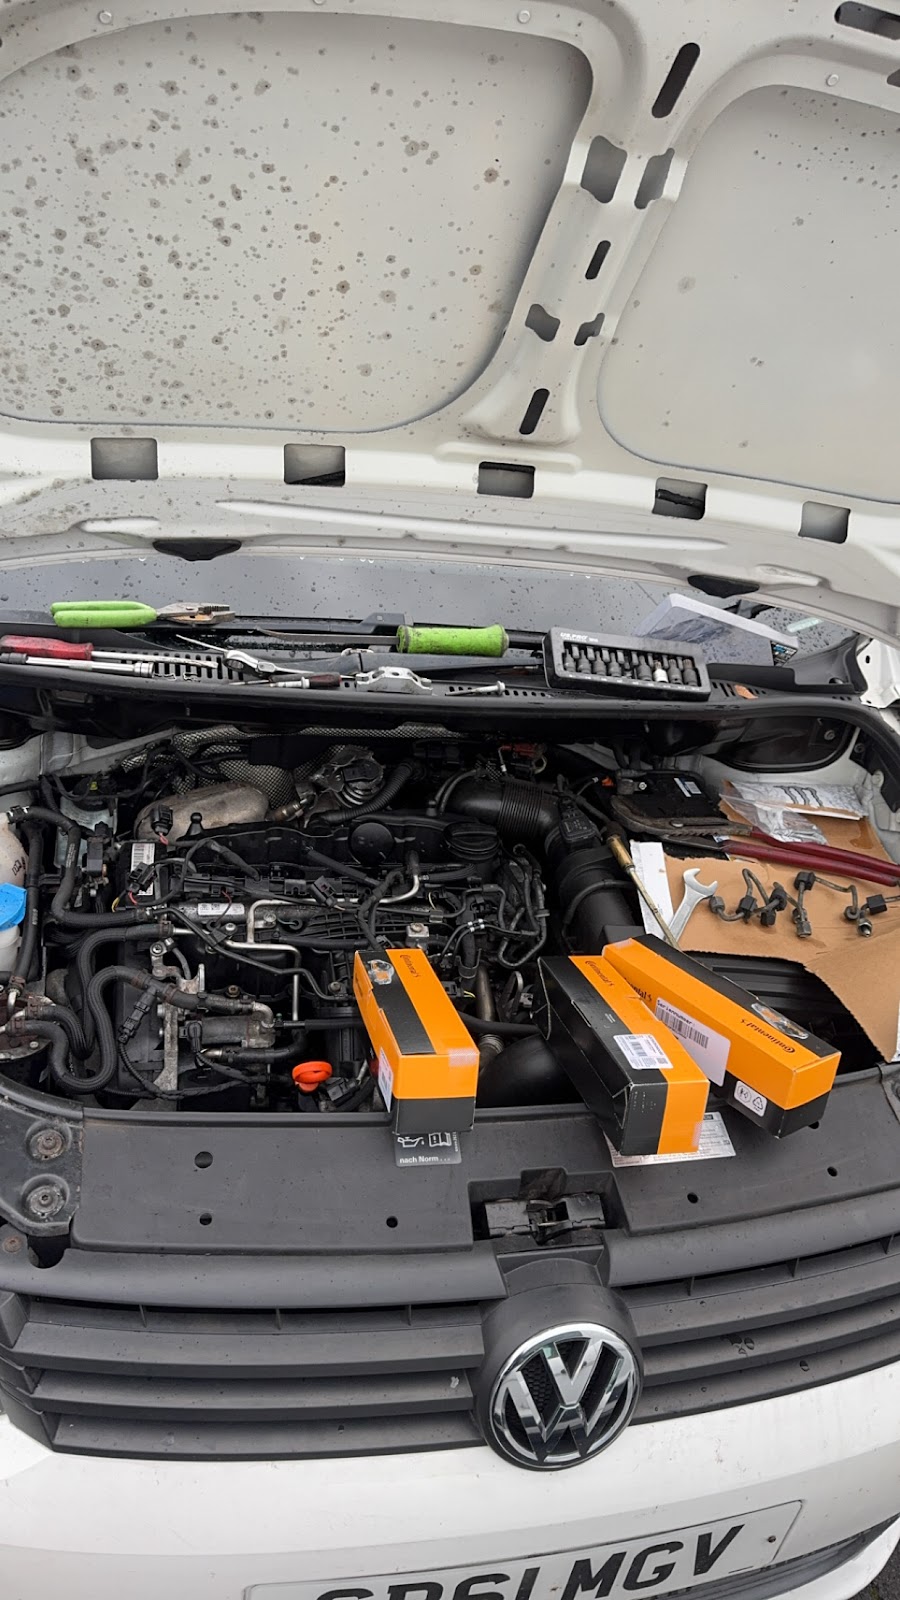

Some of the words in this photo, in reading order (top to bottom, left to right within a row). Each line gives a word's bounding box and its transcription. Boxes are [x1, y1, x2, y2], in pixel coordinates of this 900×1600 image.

[747, 1021, 796, 1054] Continental
[400, 1156, 418, 1164] nach
[560, 1524, 746, 1600] MGV
